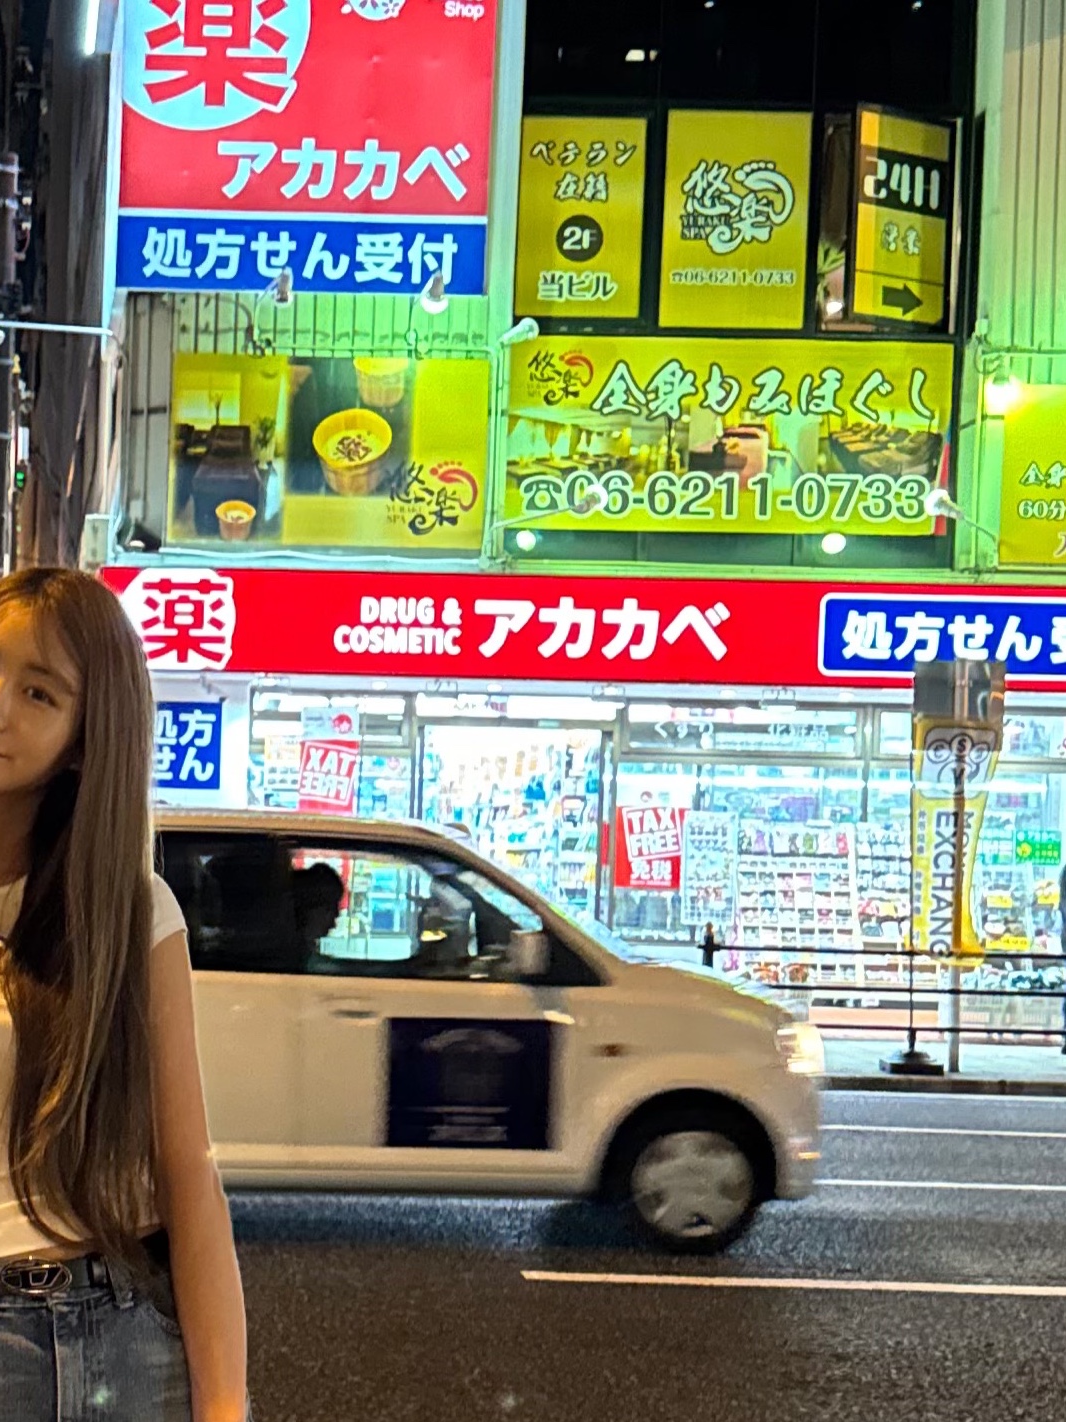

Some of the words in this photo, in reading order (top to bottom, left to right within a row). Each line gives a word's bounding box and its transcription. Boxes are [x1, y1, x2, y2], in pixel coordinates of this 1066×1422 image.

[444, 1, 485, 21] Shop
[217, 137, 470, 201] アカカベ
[864, 156, 940, 210] 24H
[142, 226, 458, 285] 処方せん受付
[563, 226, 599, 250] 2F
[683, 269, 795, 286] 06-6211-0733
[593, 360, 934, 423] 全身もみほぐし
[565, 471, 931, 523] 06-6211-0733
[141, 578, 227, 663] 薬
[360, 596, 435, 625] DRUG
[441, 597, 463, 626] &
[474, 597, 731, 661] アカカベ
[334, 625, 463, 655] COSMETIC
[626, 807, 675, 834] TAX
[629, 830, 679, 856] FREE
